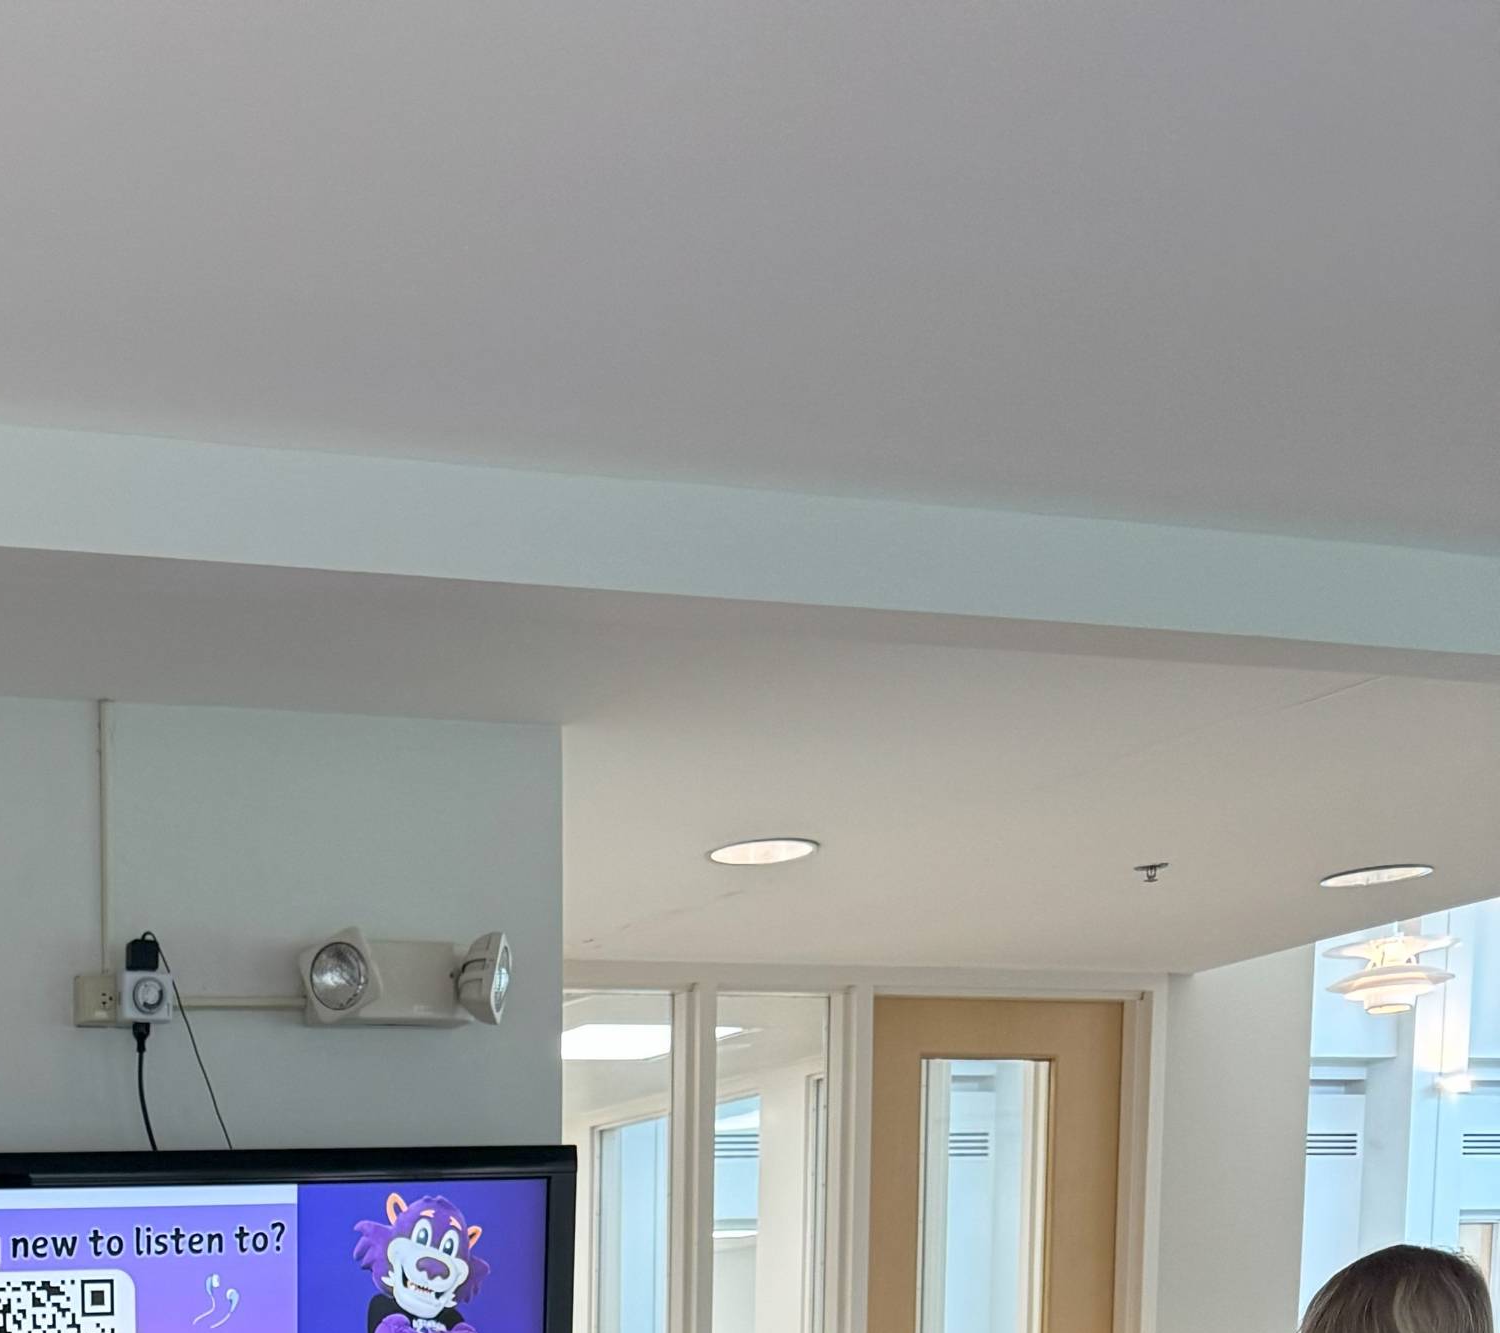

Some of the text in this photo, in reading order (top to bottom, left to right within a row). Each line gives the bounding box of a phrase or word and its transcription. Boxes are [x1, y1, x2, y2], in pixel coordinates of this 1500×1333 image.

[11, 1236, 78, 1258] new
[89, 1229, 124, 1257] to
[135, 1227, 224, 1256] listen
[235, 1222, 286, 1254] to?
